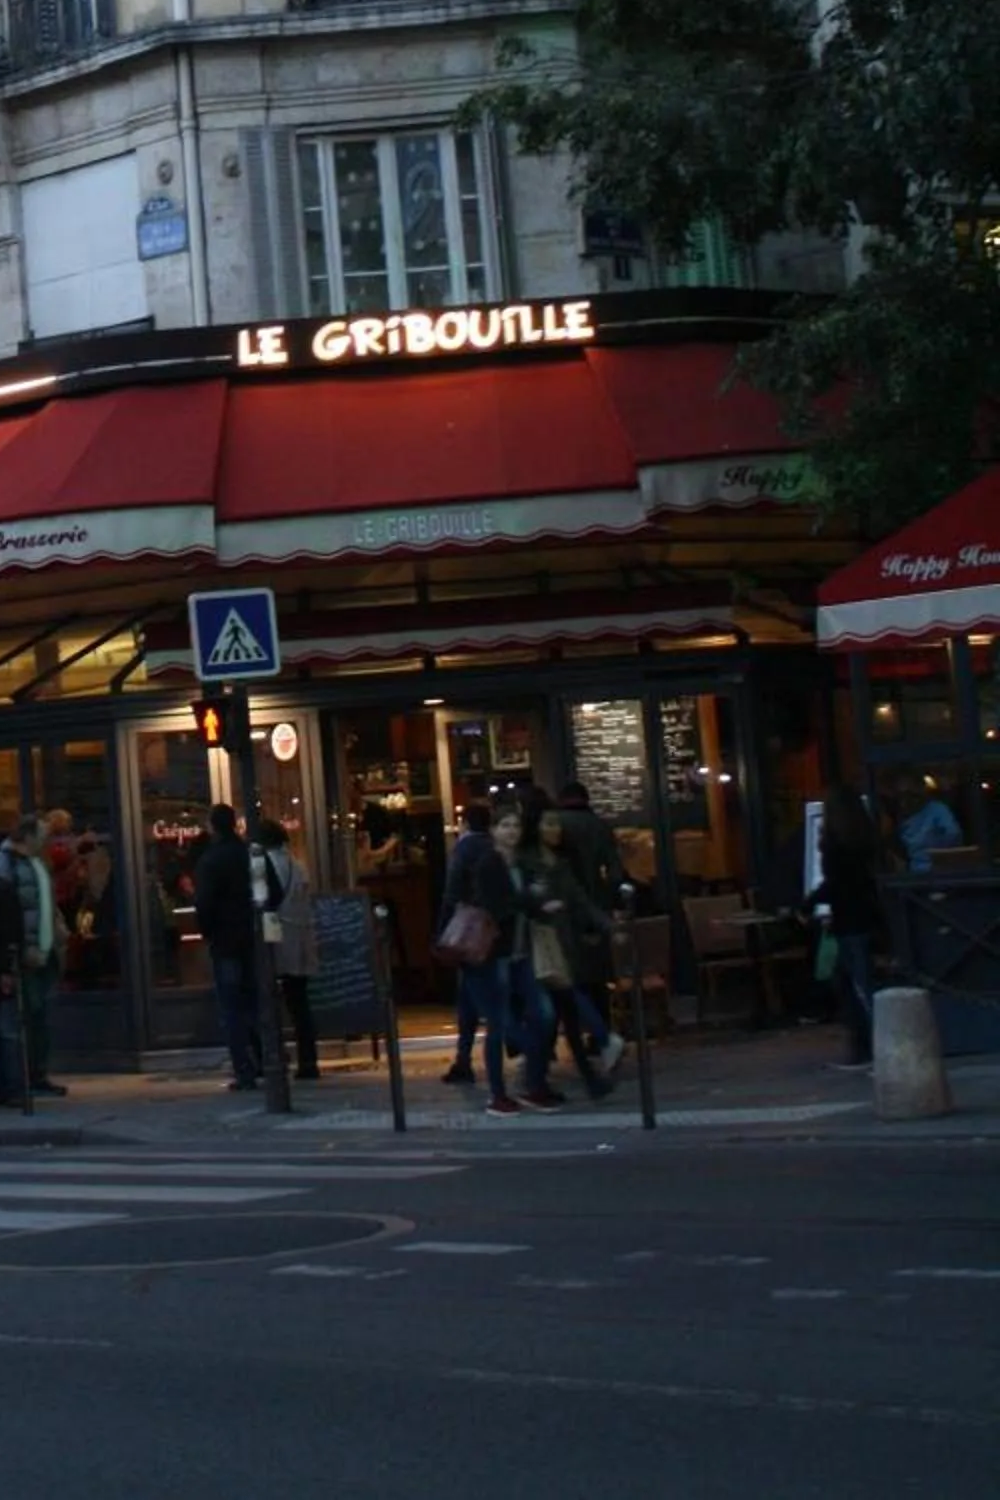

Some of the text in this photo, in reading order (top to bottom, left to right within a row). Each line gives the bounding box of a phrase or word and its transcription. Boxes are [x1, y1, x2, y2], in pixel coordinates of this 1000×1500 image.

[237, 325, 288, 367] LE
[354, 510, 493, 543] LE GRIBOUILLE
[880, 553, 950, 584] Happy
